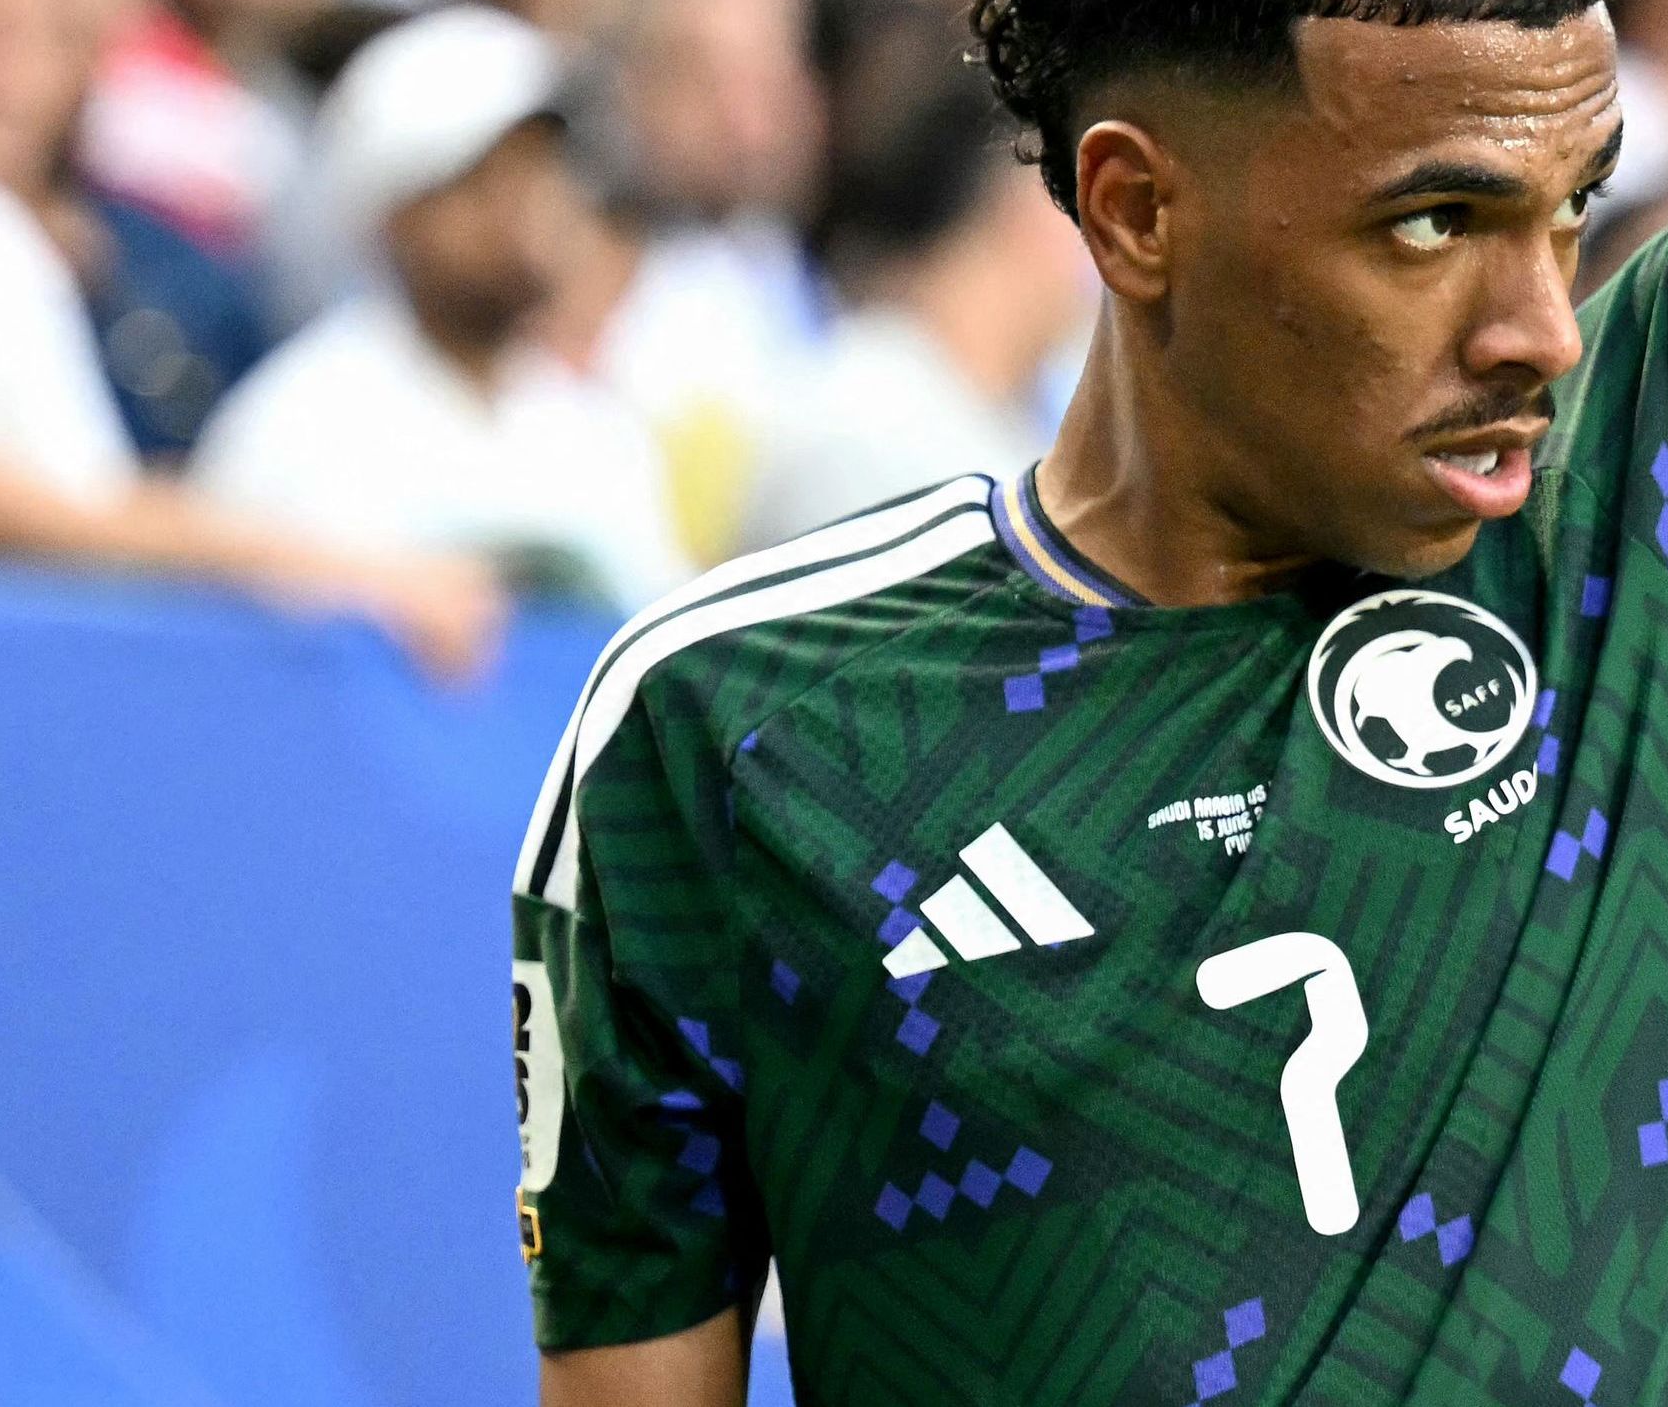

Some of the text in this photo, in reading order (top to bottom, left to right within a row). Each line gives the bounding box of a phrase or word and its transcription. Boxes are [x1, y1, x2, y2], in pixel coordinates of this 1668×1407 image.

[1444, 678, 1501, 718] SAFF
[1147, 800, 1192, 830] SAUDI
[1443, 760, 1538, 844] SAUD
[1196, 932, 1368, 1236] 7
